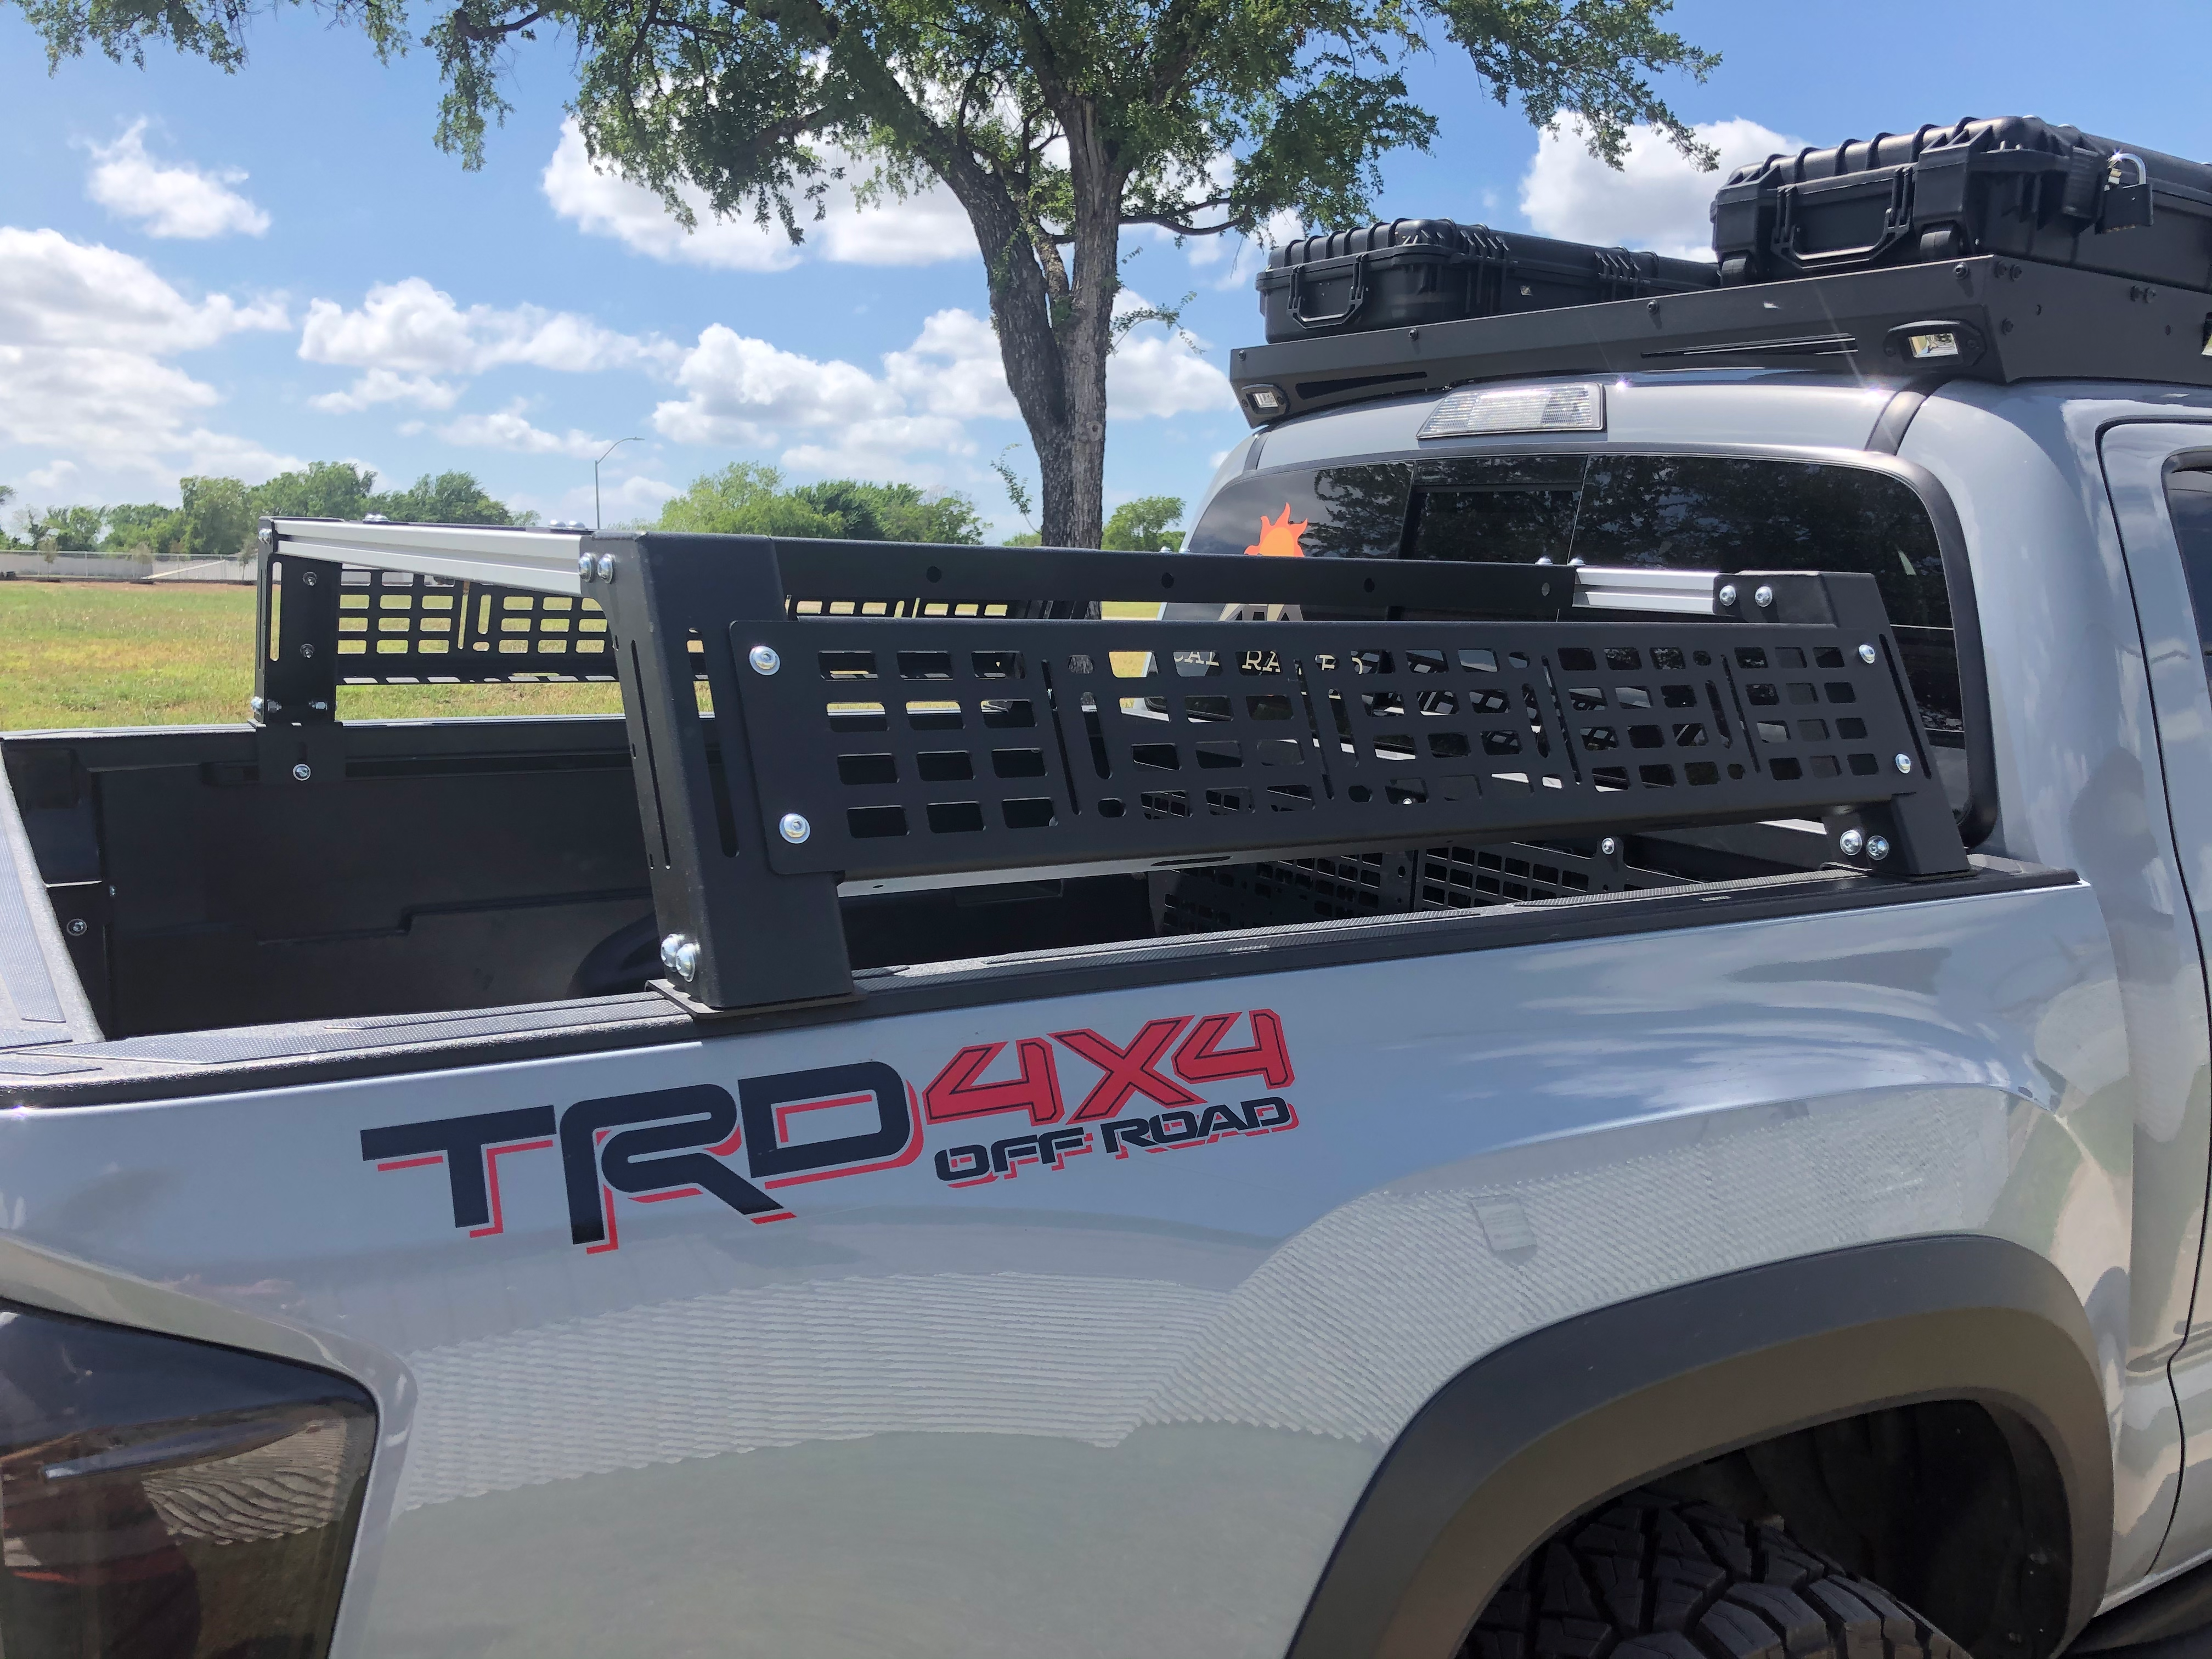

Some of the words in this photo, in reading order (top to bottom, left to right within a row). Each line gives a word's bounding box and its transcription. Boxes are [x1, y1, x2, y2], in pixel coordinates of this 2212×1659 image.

[360, 1061, 924, 1255] TRD
[934, 1126, 1094, 1189] OFF
[1099, 1096, 1300, 1160] ROAD
